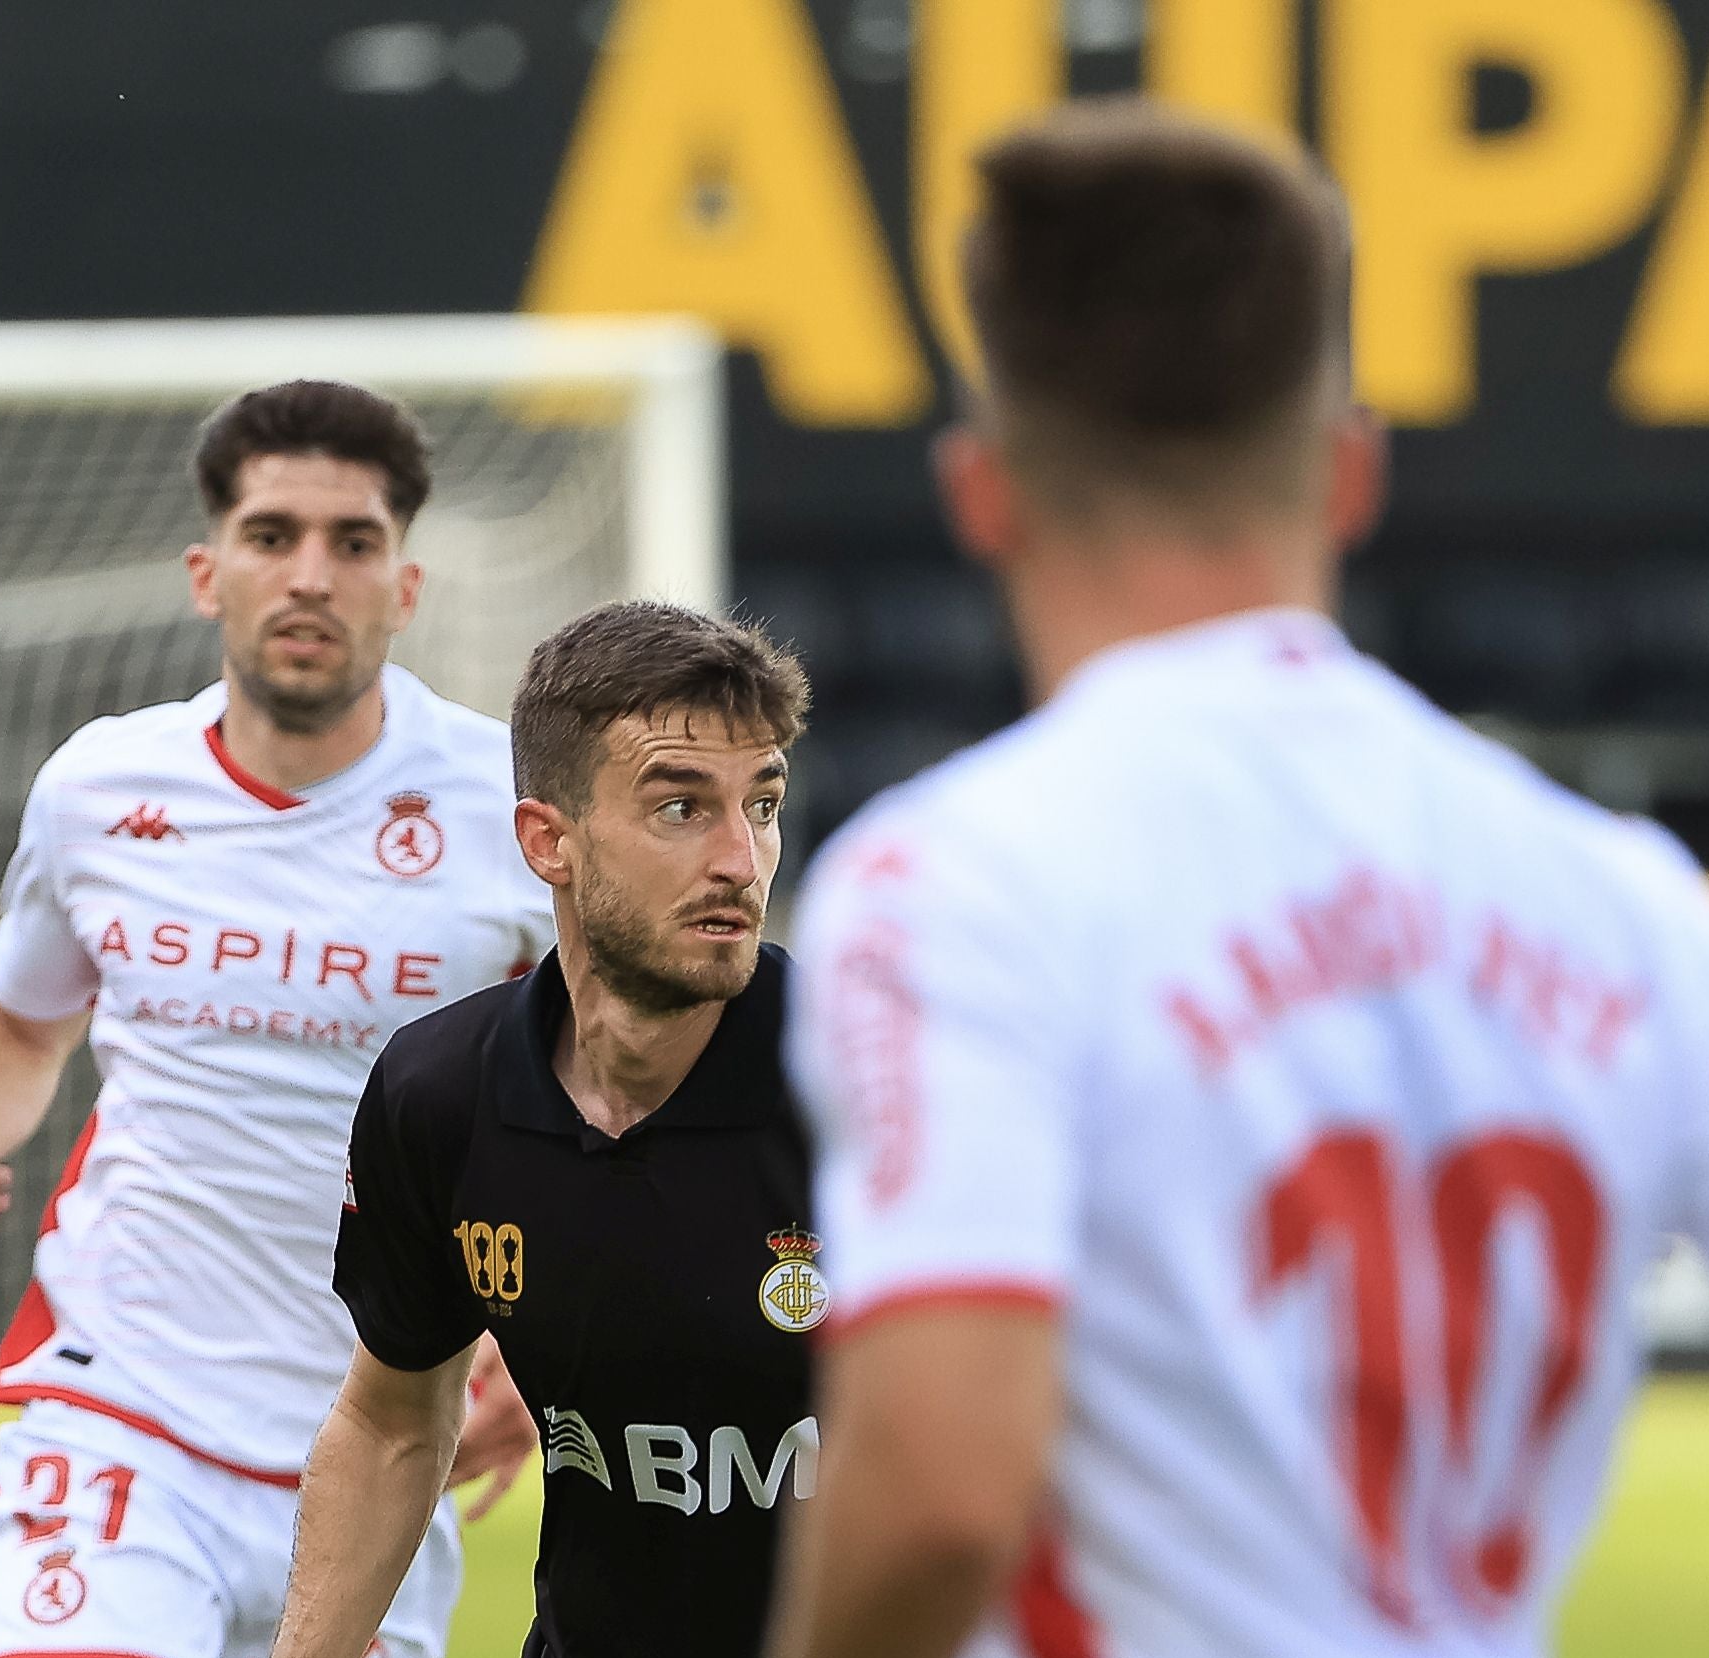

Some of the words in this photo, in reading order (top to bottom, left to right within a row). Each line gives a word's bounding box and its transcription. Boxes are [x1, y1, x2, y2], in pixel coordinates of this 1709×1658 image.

[98, 918, 444, 1002] ASPIRE
[133, 996, 380, 1050] ACADEMY
[453, 1220, 523, 1301] 100
[1252, 1122, 1606, 1632] 10
[15, 1454, 136, 1544] 21
[624, 1416, 821, 1516] BM
